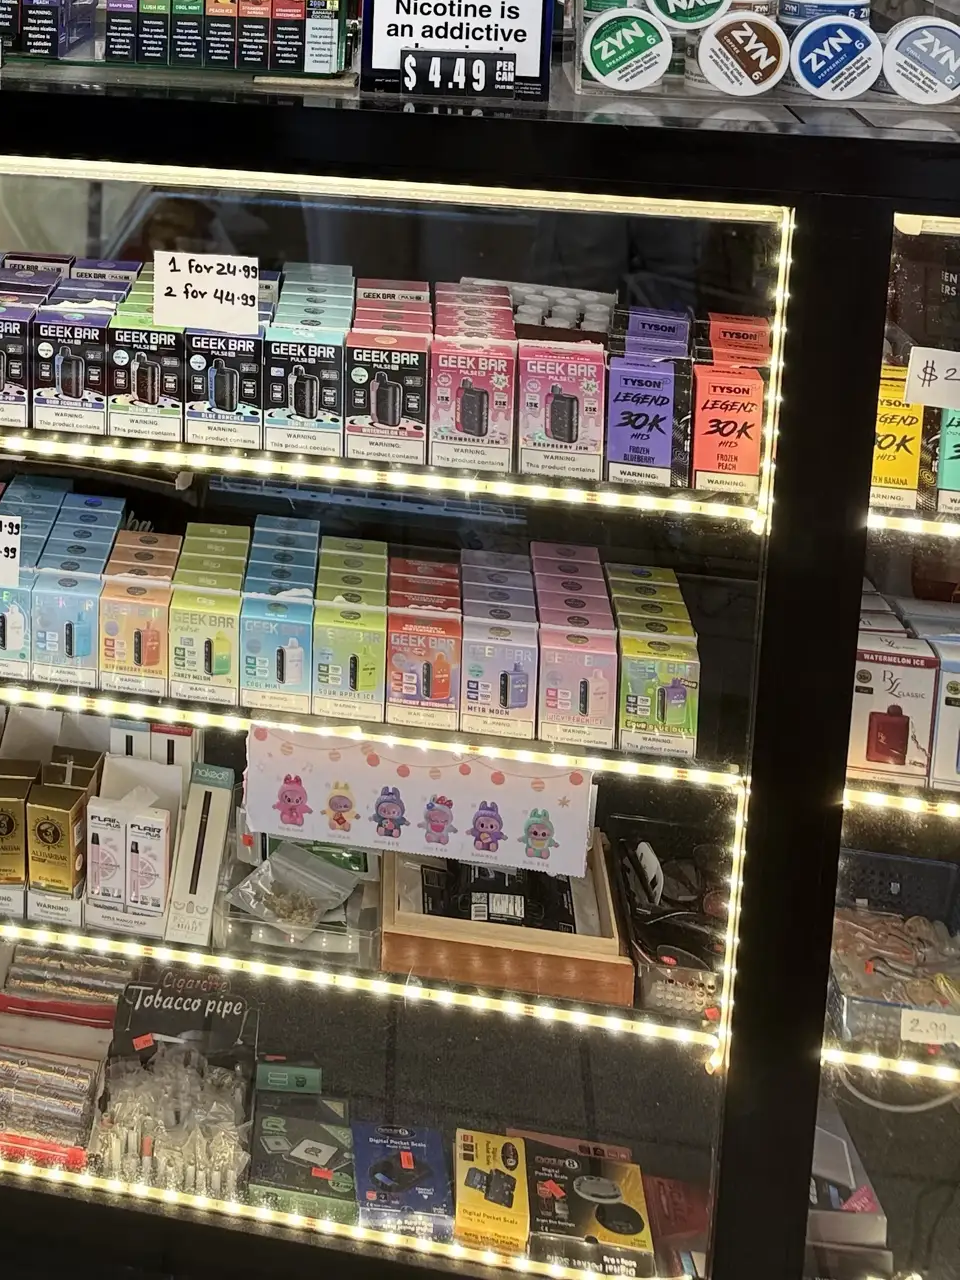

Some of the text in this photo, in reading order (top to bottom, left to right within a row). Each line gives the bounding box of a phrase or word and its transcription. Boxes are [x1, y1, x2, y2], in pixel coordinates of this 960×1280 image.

[500, 1, 520, 20] is
[387, 22, 527, 42] an addictive
[496, 60, 514, 71] PER
[495, 71, 514, 82] CAN
[168, 257, 181, 273] 1
[216, 261, 258, 279] 24.99
[164, 285, 177, 298] 2
[213, 287, 256, 307] 44.99
[640, 322, 676, 334] TYSON
[115, 330, 176, 346] GEEK BAR
[722, 330, 757, 341] TYSON
[438, 355, 507, 372] GEEK BAR
[622, 377, 662, 389] TYSON
[613, 392, 670, 407] LEGEND
[615, 411, 667, 435] 30K
[705, 419, 755, 441] 30K
[630, 432, 651, 441] HITS
[628, 446, 651, 455] FROZEN
[623, 453, 656, 464] BLUEBERRY
[716, 454, 738, 462] FROZEN
[718, 462, 737, 471] PEACH
[863, 654, 912, 665] WATERMELON
[898, 691, 926, 699] CLASSIC
[128, 985, 243, 1018] Tobacco pipe
